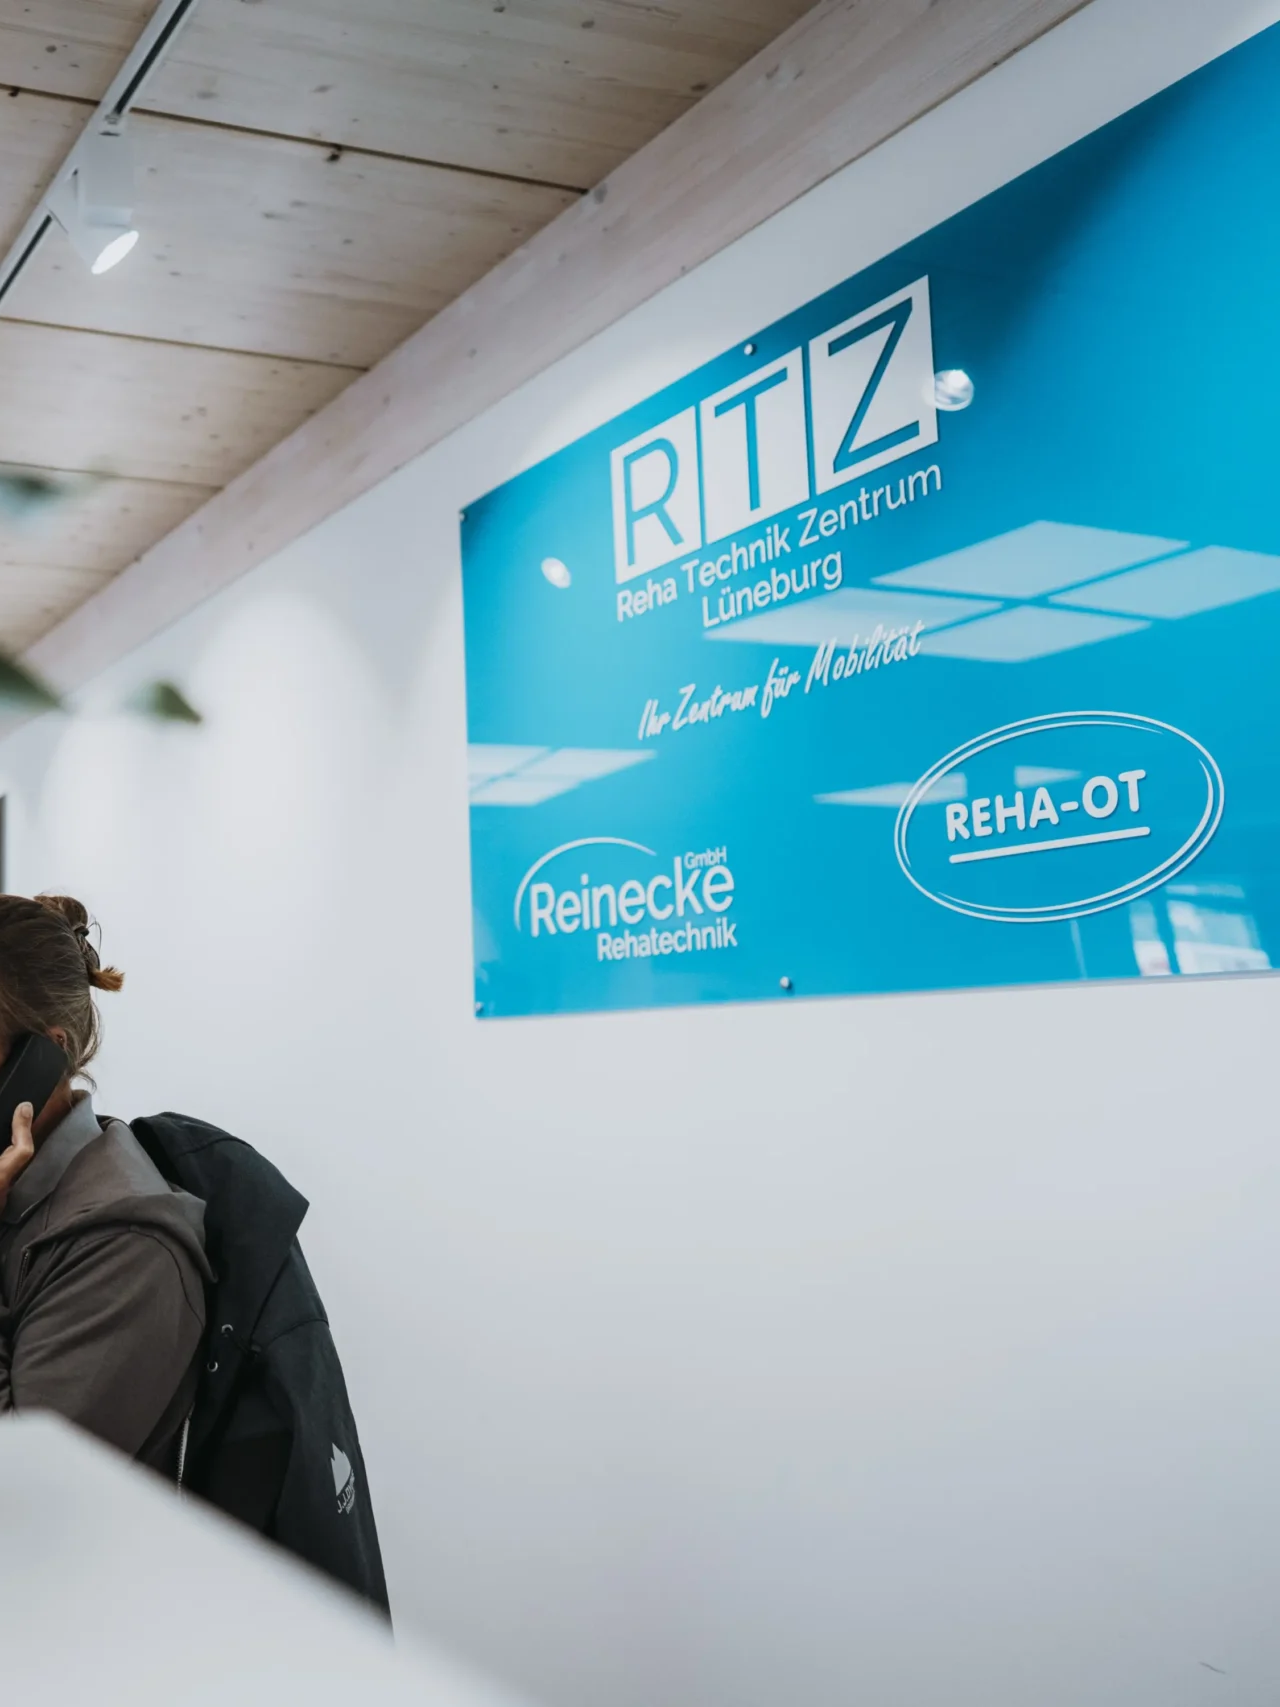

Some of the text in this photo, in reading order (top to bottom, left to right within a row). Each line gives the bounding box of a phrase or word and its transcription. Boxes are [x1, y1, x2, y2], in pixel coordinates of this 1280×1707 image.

[623, 296, 921, 567] RTZ
[616, 464, 943, 622] Reha Technik Zentrum
[702, 551, 844, 628] Lüneburg
[638, 620, 926, 740] Ihr Zentrum für Mobilität
[946, 769, 1147, 842] REHA-OT
[530, 856, 736, 938] Reinecke
[684, 846, 728, 869] GmbH
[596, 917, 738, 961] Rehatechnik
